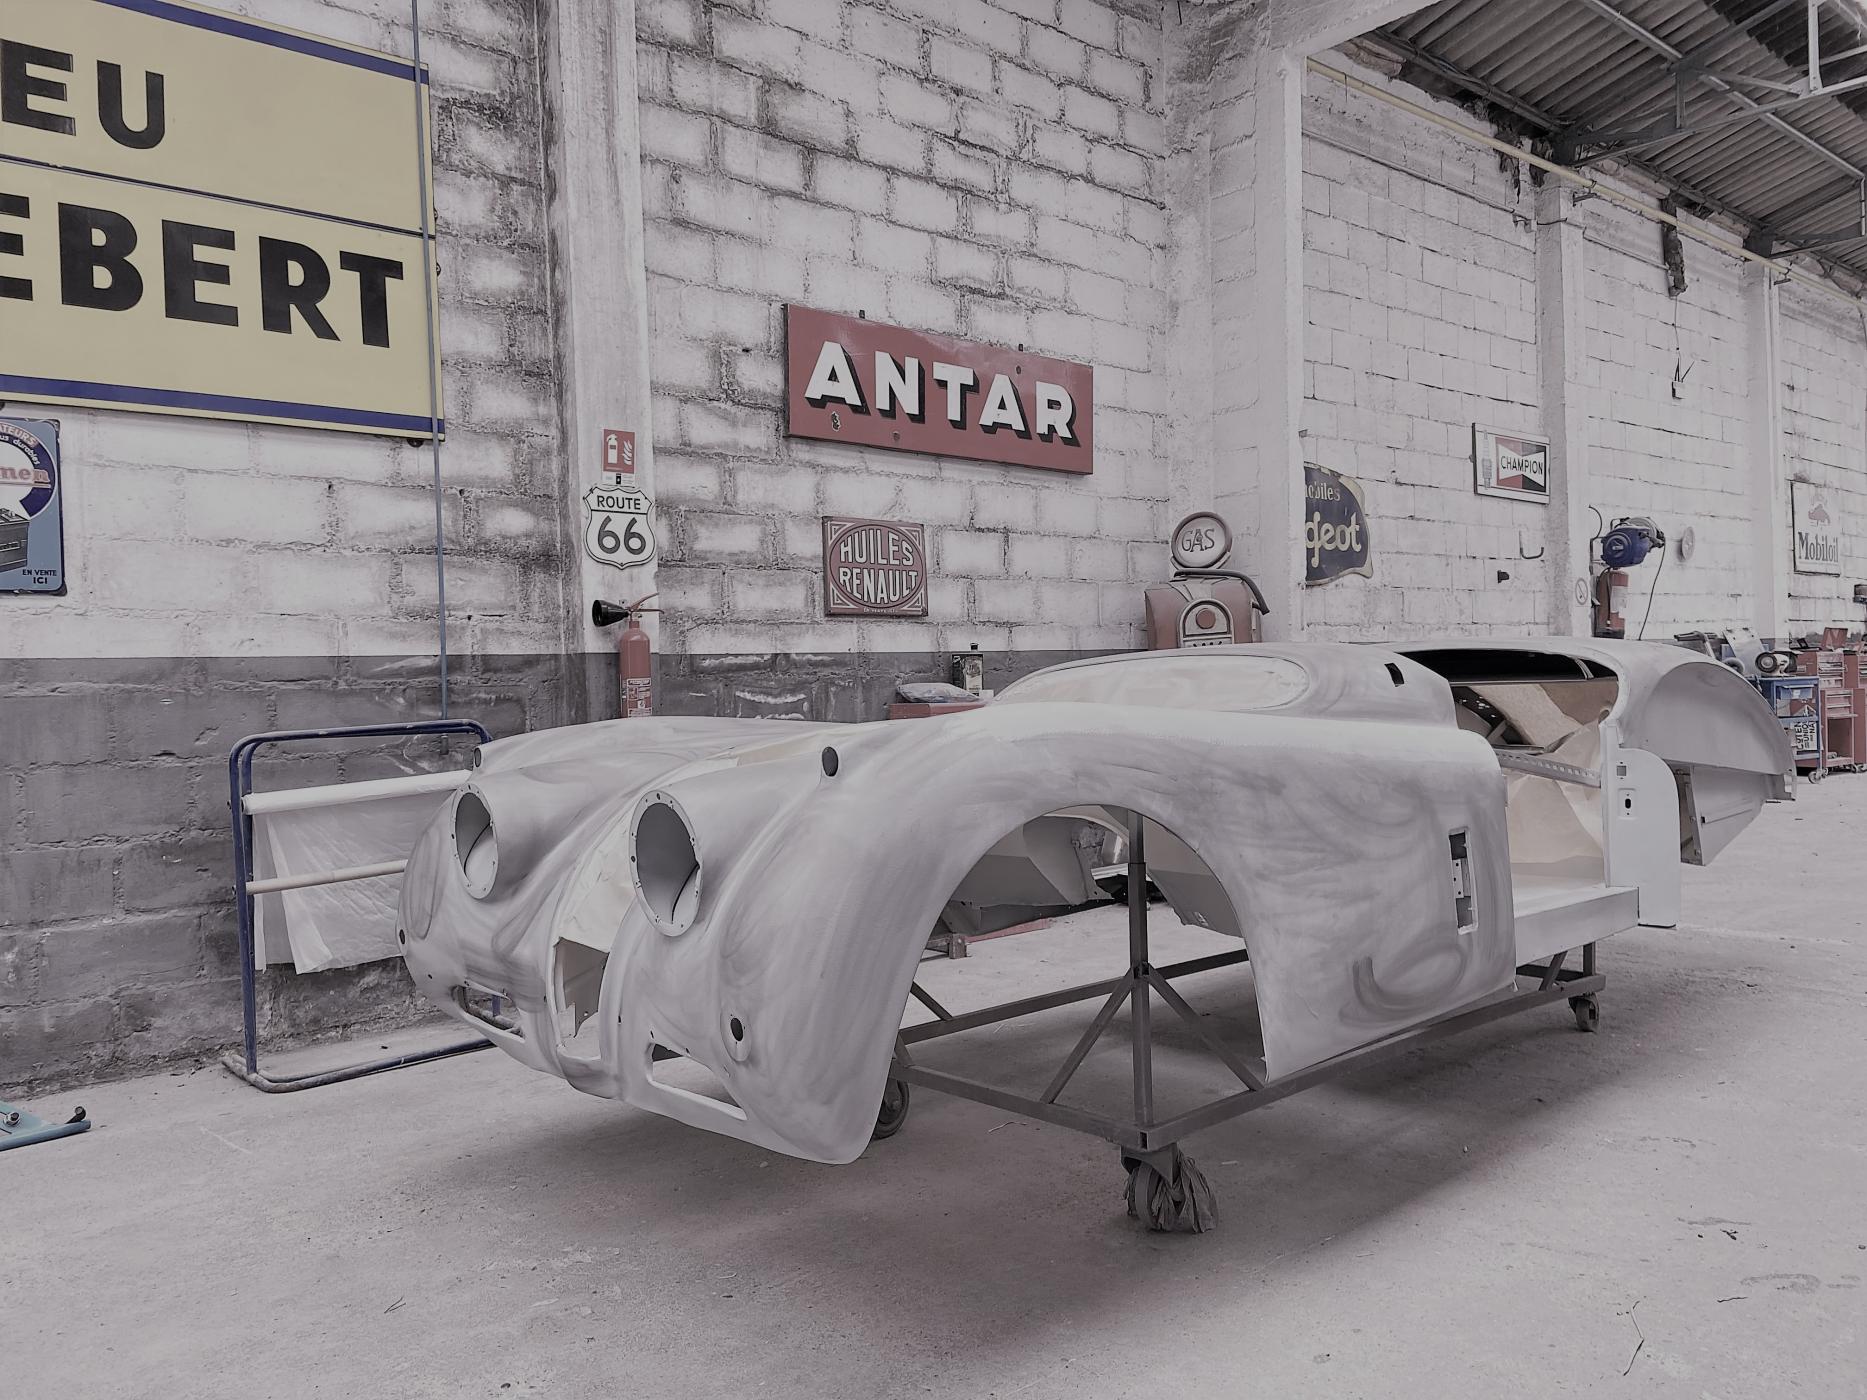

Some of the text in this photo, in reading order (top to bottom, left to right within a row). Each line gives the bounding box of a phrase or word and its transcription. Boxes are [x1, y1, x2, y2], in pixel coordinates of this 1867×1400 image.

[1, 38, 165, 149] EU
[804, 340, 1080, 445] ANTAR
[1500, 456, 1544, 475] CHAMPION
[597, 495, 641, 510] ROUTE
[598, 515, 646, 555] 66
[840, 529, 914, 566] HUILES
[1181, 528, 1215, 552] GAS
[1798, 531, 1839, 563] Mobiloil
[33, 576, 48, 584] ICI
[839, 567, 918, 604] RENAULT
